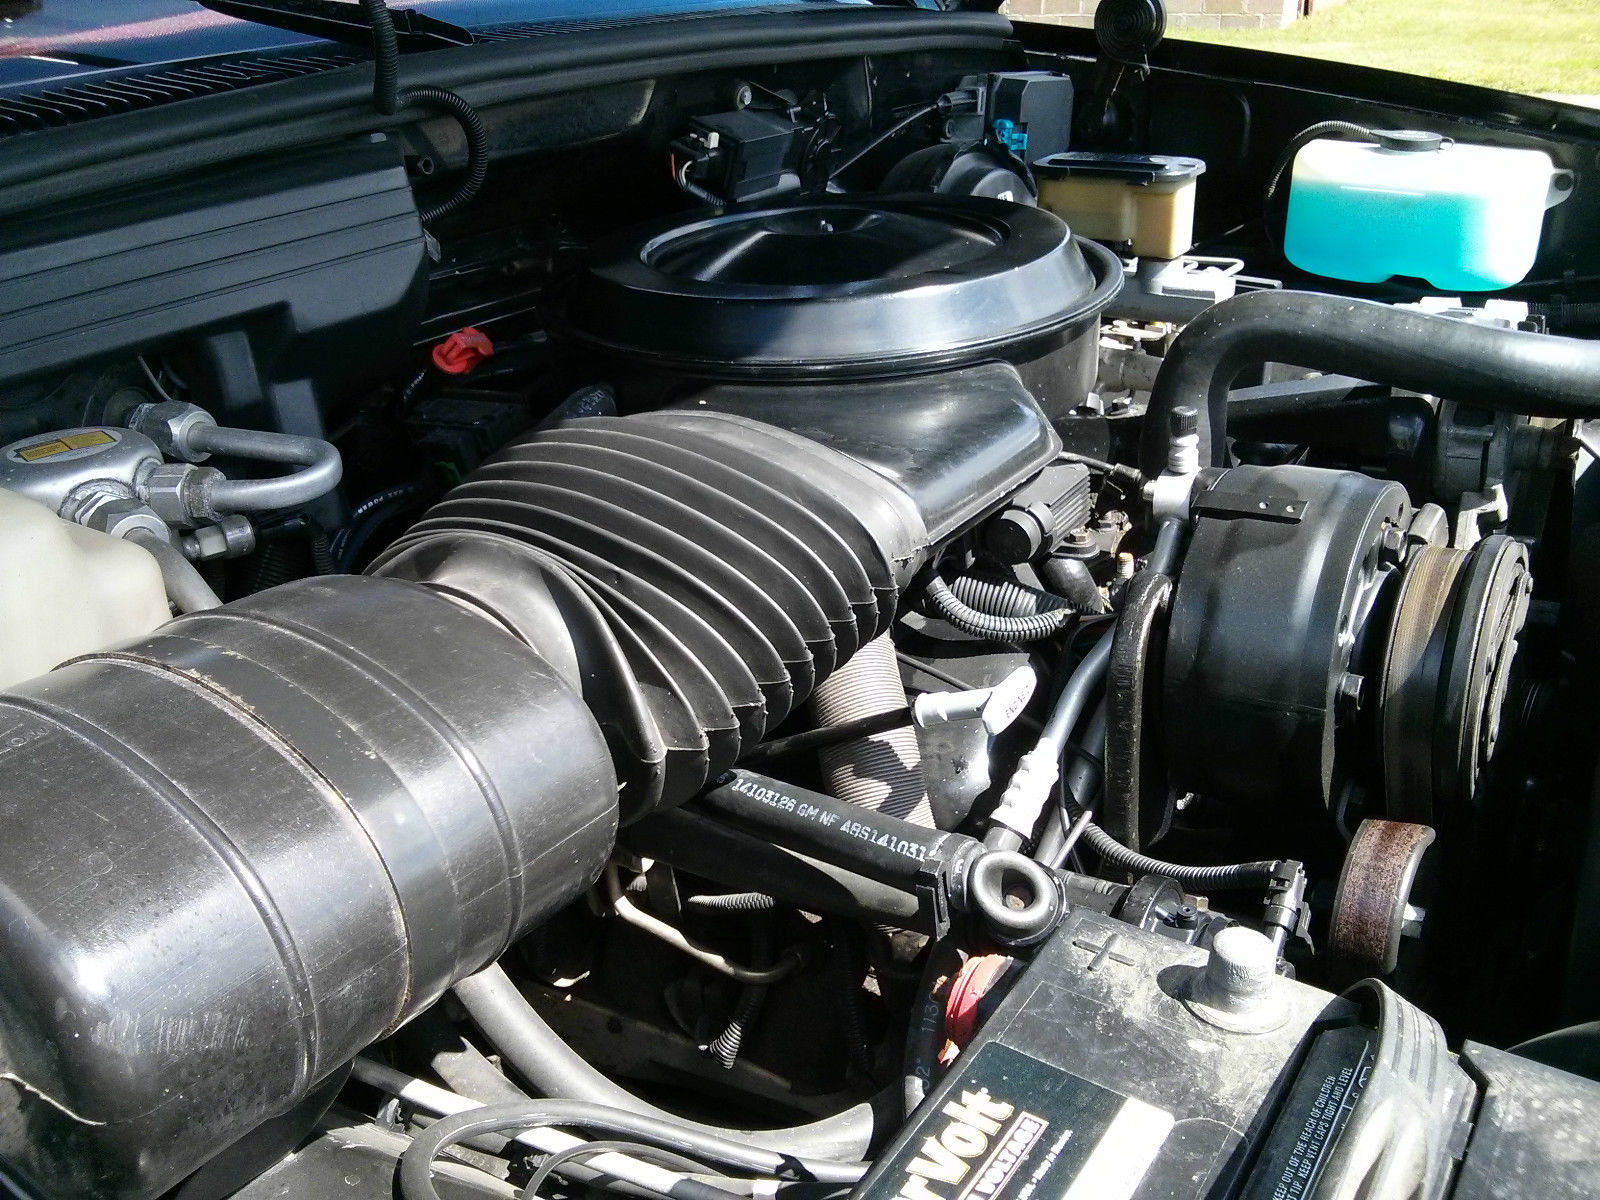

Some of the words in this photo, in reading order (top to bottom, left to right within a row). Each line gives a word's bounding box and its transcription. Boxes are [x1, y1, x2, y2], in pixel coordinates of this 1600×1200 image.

[731, 779, 797, 812] 14103126
[797, 803, 820, 820] GM
[819, 811, 840, 827] NF
[1314, 1075, 1336, 1108] CHILDREN
[1298, 1159, 1312, 1179] KEEP
[1306, 1140, 1320, 1159] VENT
[1314, 1121, 1329, 1140] CAPS
[1322, 1101, 1338, 1121] TIGHT
[1331, 1086, 1344, 1101] AND
[1338, 1067, 1353, 1087] LEVEL
[1311, 1108, 1322, 1118] OF
[1300, 1118, 1317, 1141] REACH
[891, 1090, 1014, 1200] rVolt
[974, 1117, 1041, 1194] VOLTAGE
[1293, 1141, 1307, 1156] THE
[1282, 1167, 1296, 1183] OUT
[1289, 1156, 1300, 1167] OF
